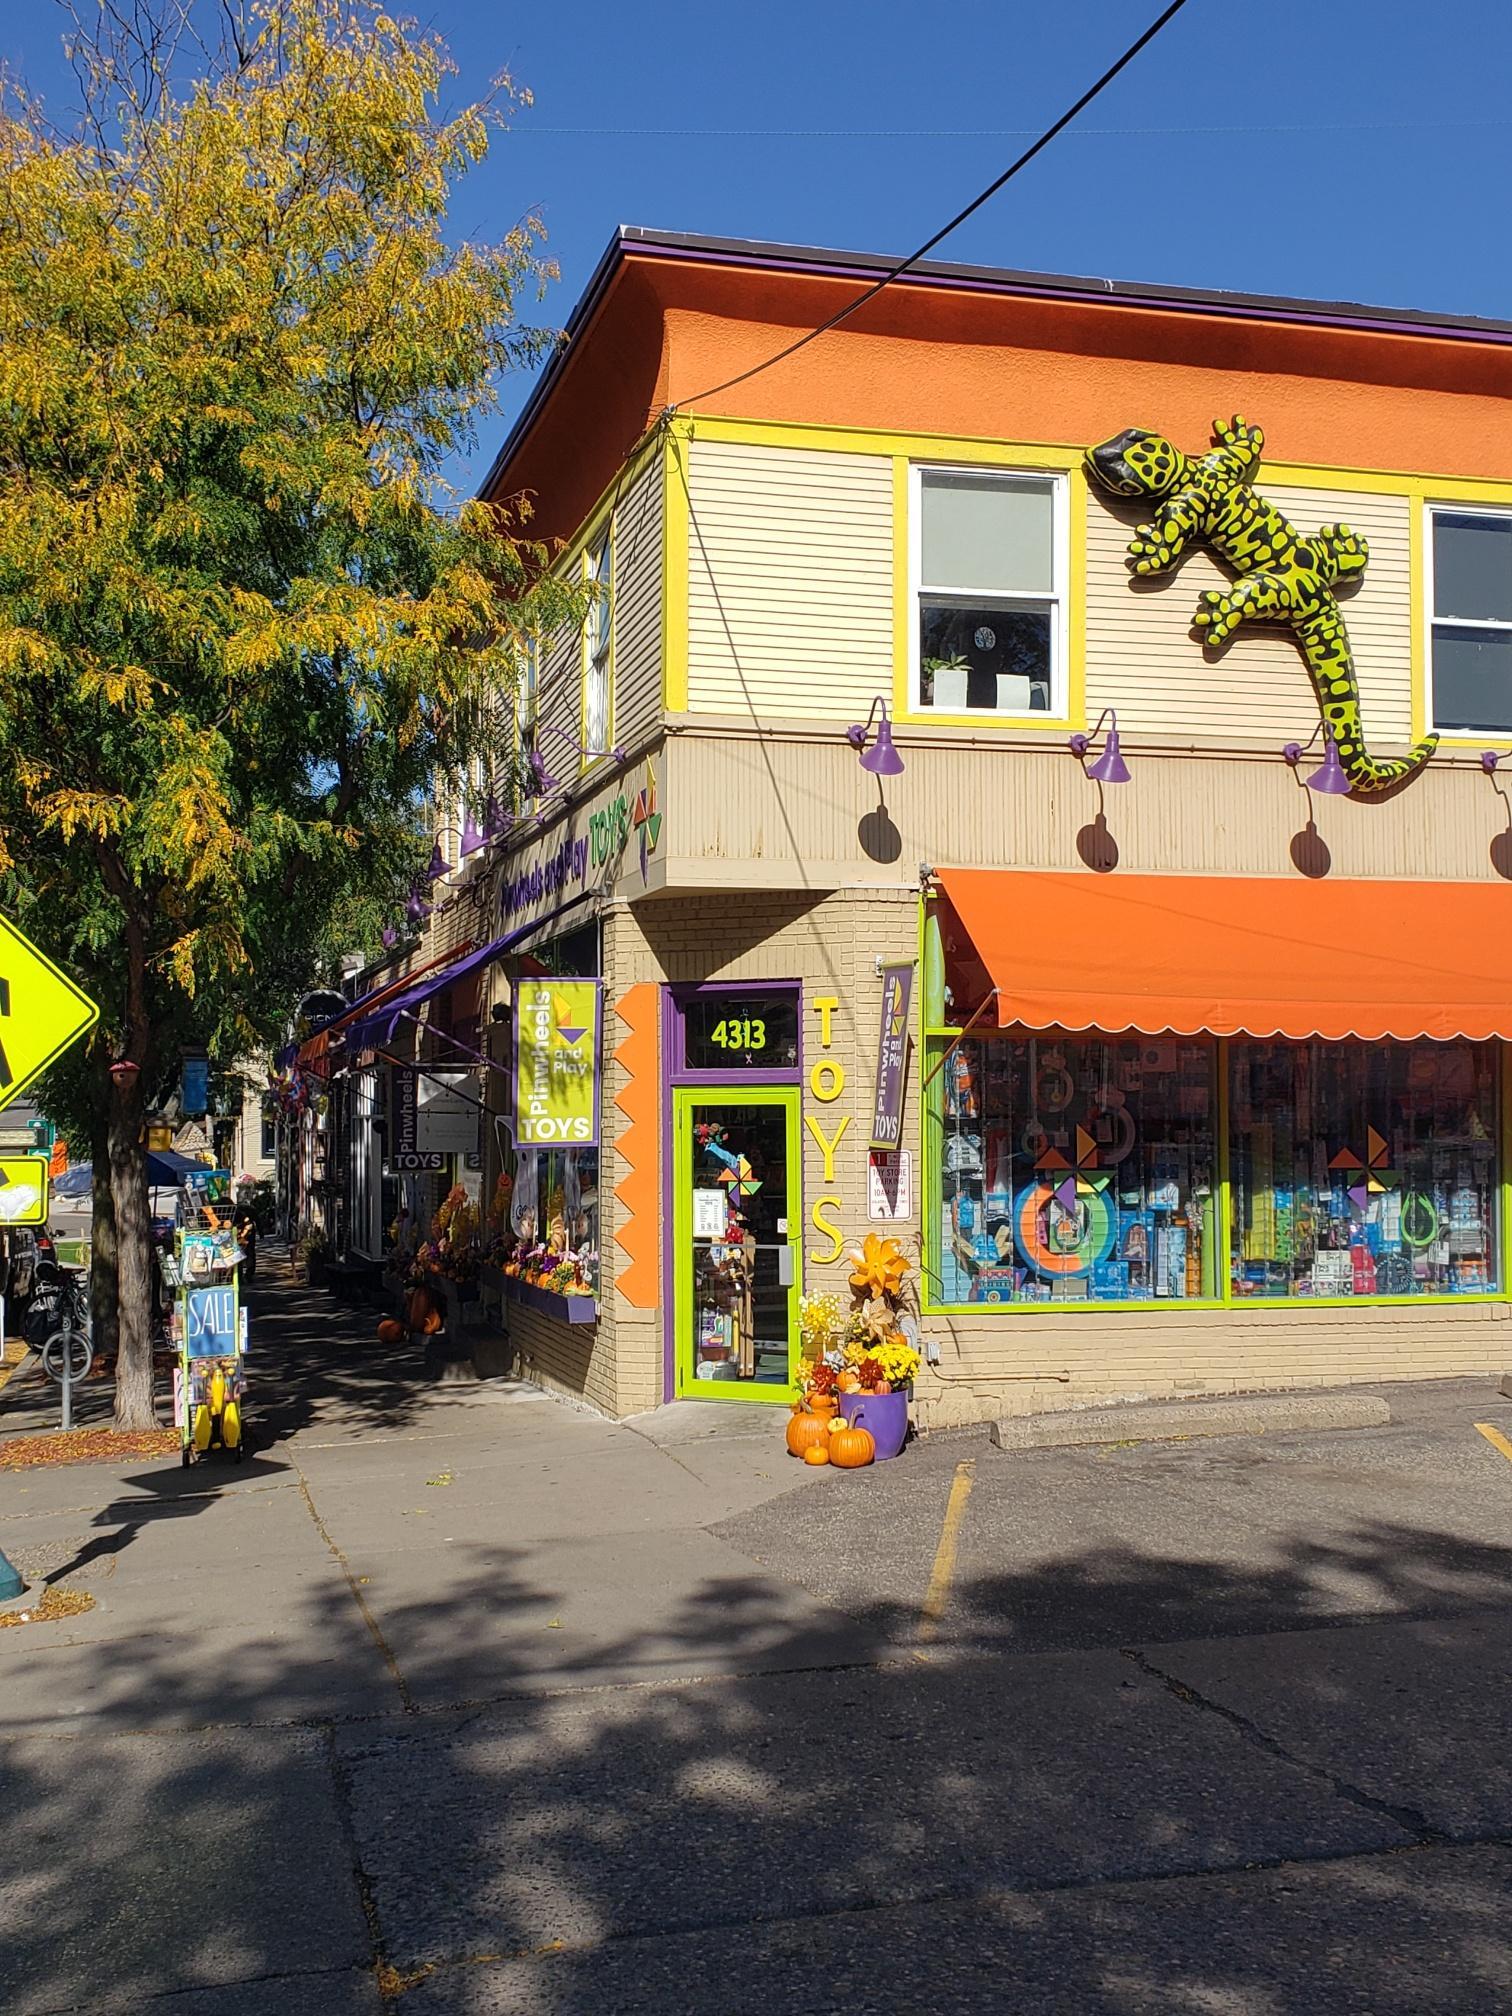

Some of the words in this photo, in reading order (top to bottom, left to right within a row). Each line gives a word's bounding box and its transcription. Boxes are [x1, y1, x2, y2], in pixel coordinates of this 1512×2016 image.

[544, 842, 566, 895] and
[564, 834, 589, 892] Play
[588, 794, 628, 870] TOYS
[711, 1019, 766, 1049] 4313
[877, 975, 896, 1112] Pinwheels
[526, 990, 550, 1116] Pinwheels
[555, 1047, 583, 1060] and
[888, 1052, 903, 1072] Play
[553, 1061, 588, 1077] Play
[396, 1070, 413, 1153] Pinwheels
[522, 1117, 590, 1140] TOYS
[804, 996, 851, 1265] TOYS
[874, 1115, 898, 1139] TOYS
[394, 1154, 442, 1169] TOYS
[886, 1168, 907, 1176] STORE
[875, 1177, 904, 1185] PARKING
[188, 1291, 234, 1337] SALE
